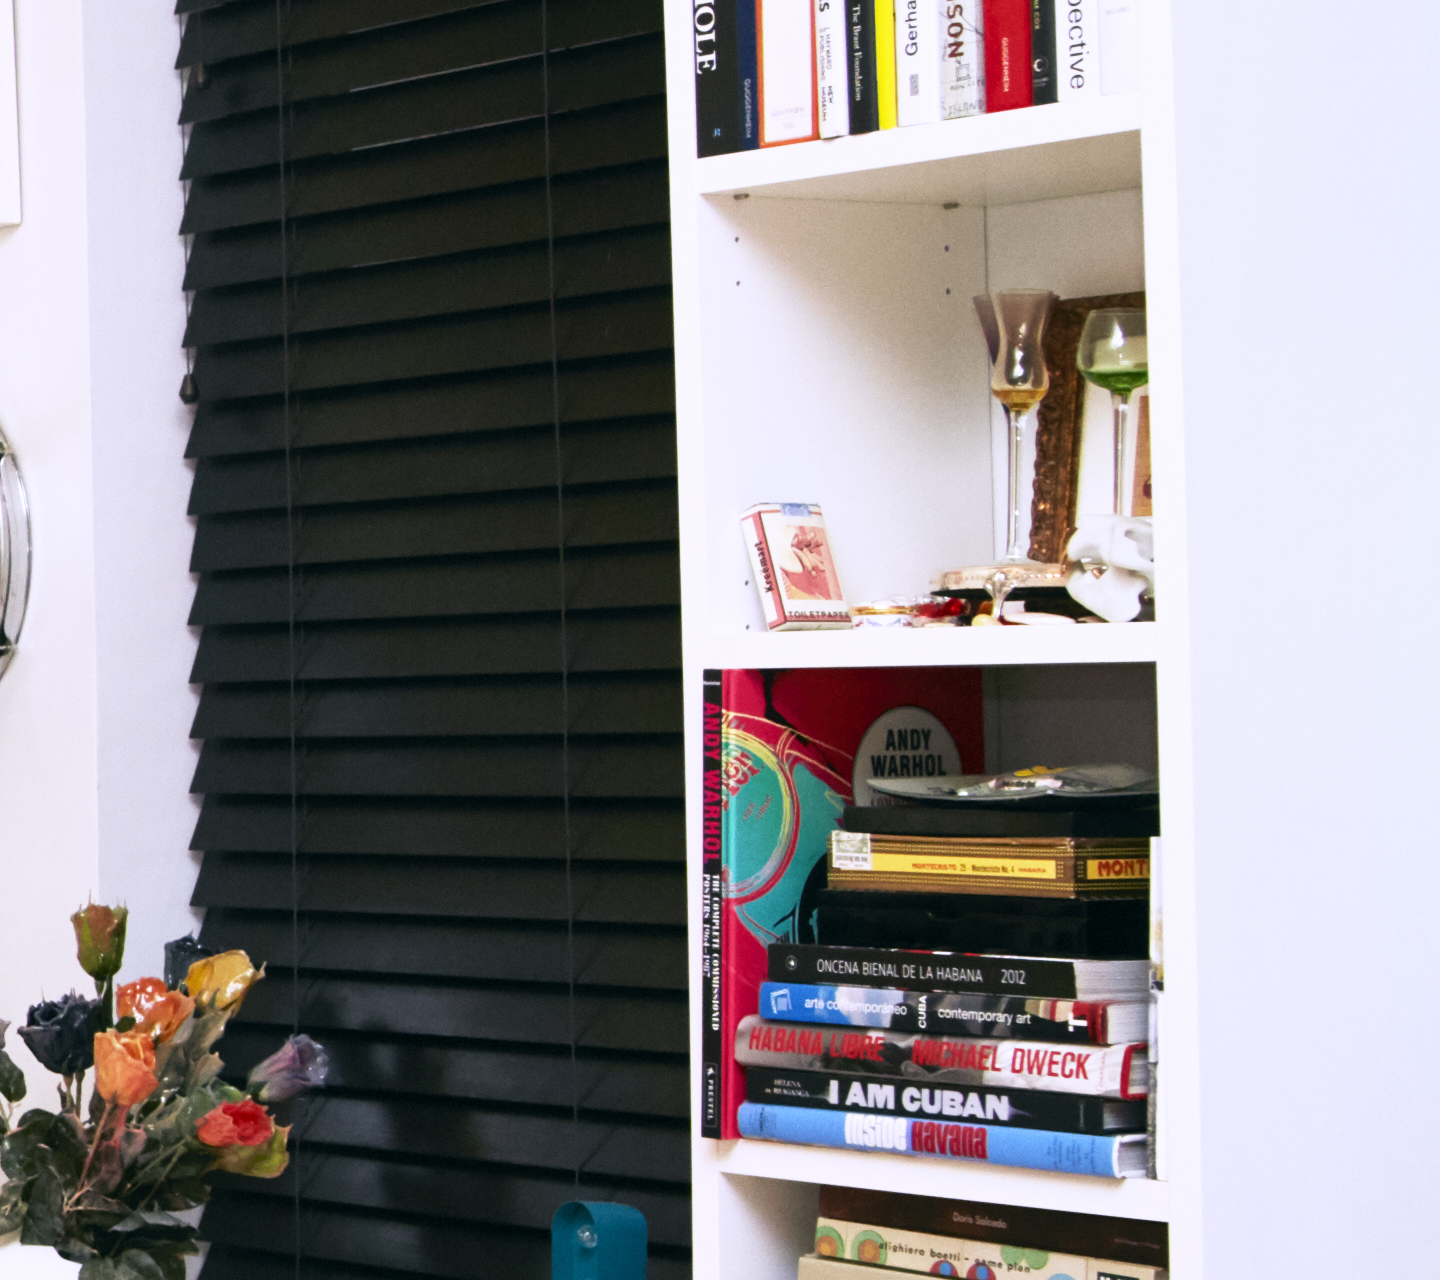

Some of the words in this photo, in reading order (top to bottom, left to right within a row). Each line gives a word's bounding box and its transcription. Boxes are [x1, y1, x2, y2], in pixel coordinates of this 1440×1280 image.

[753, 540, 773, 594] Kreemart
[702, 701, 720, 761] ANDY
[884, 727, 933, 752] ANDY
[870, 753, 947, 778] WARHOL
[703, 767, 721, 865] WARHOL
[711, 874, 720, 892] THE
[711, 897, 720, 944] COMPLETE
[816, 958, 860, 975] ONCENA
[861, 961, 900, 978] BIENAL
[901, 963, 918, 979] DE
[919, 965, 934, 980] LA
[935, 966, 983, 983] HABANA
[1000, 969, 1027, 985] 2012
[917, 995, 928, 1029] CUBA
[937, 1007, 1013, 1027] contemporary
[1015, 1011, 1031, 1025] art
[748, 1029, 824, 1057] HABANA
[829, 1034, 885, 1063] LIBRE
[911, 1040, 1001, 1073] MICHAEL
[1011, 1047, 1090, 1081] DWECK
[828, 1079, 840, 1105] I
[845, 1082, 896, 1111] AM
[901, 1088, 1011, 1122] CUBAN
[844, 1113, 908, 1151] Inside
[911, 1121, 988, 1160] Havana
